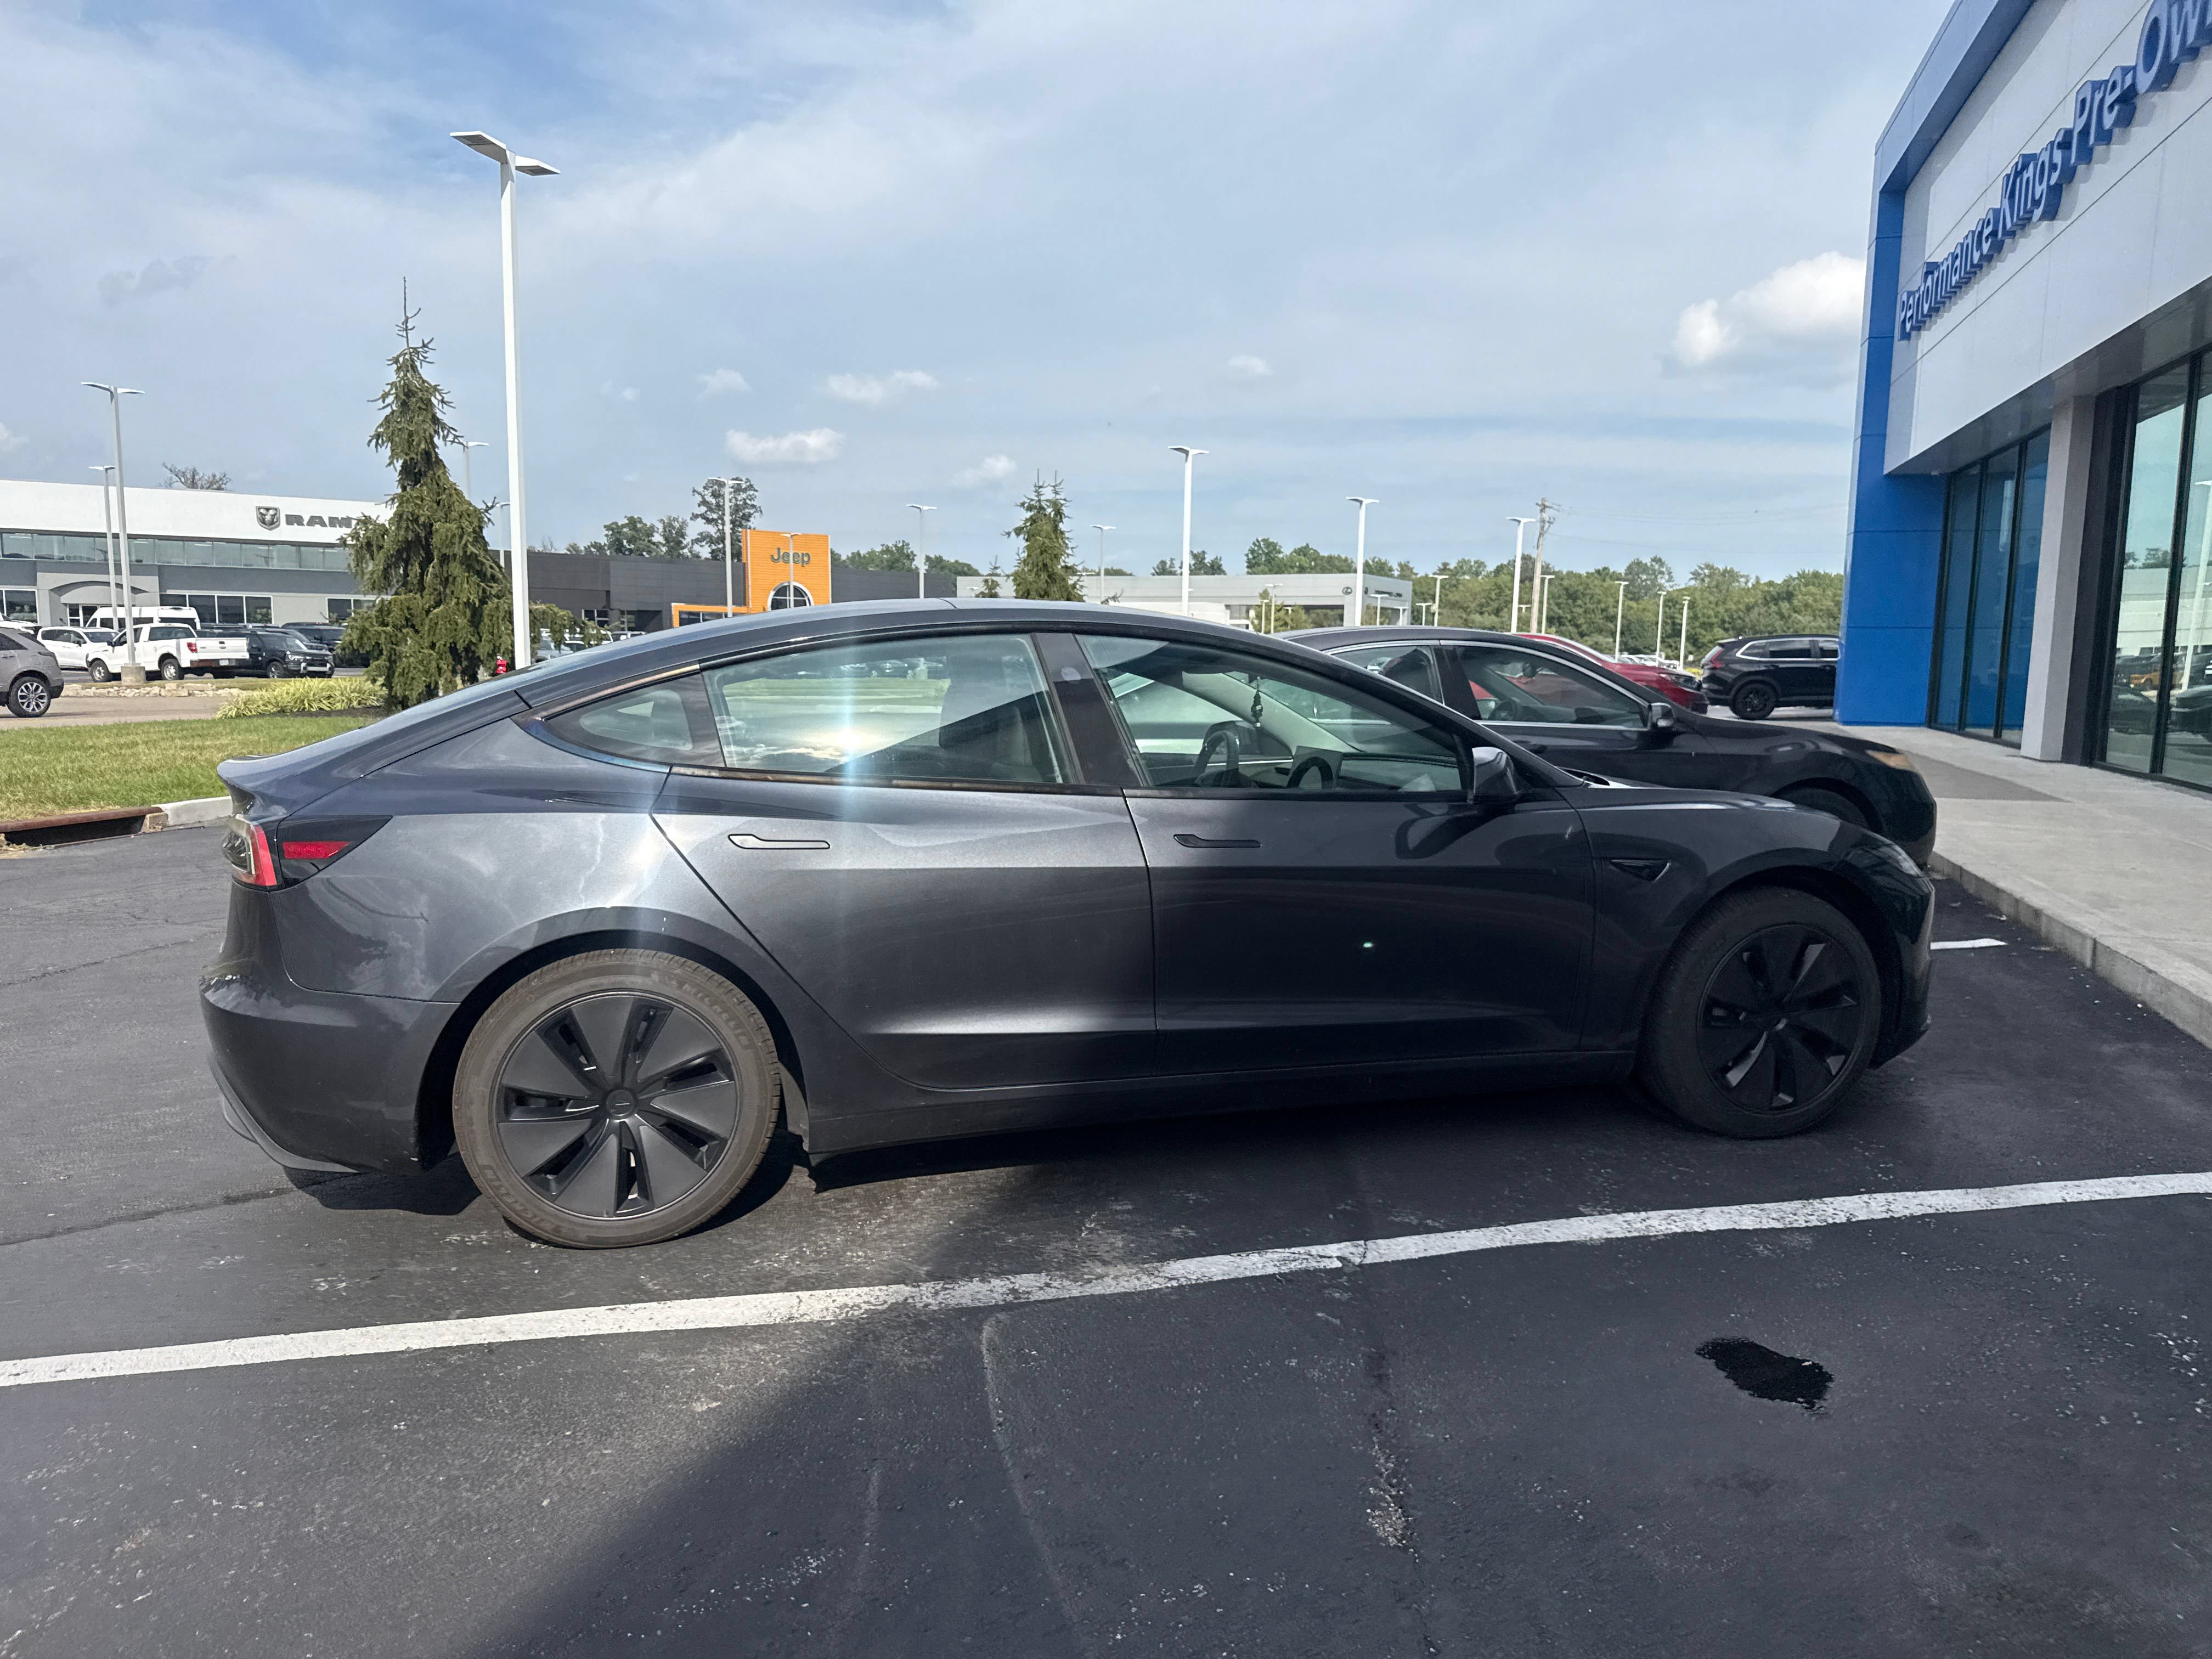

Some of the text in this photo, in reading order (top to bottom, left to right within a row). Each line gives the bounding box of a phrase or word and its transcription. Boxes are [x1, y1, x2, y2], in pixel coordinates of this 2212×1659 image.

[1898, 0, 2212, 341] Performance Kings Pre-Ow
[285, 514, 353, 528] RAM
[770, 547, 810, 567] Jeep
[682, 983, 752, 1046] MICHELIN
